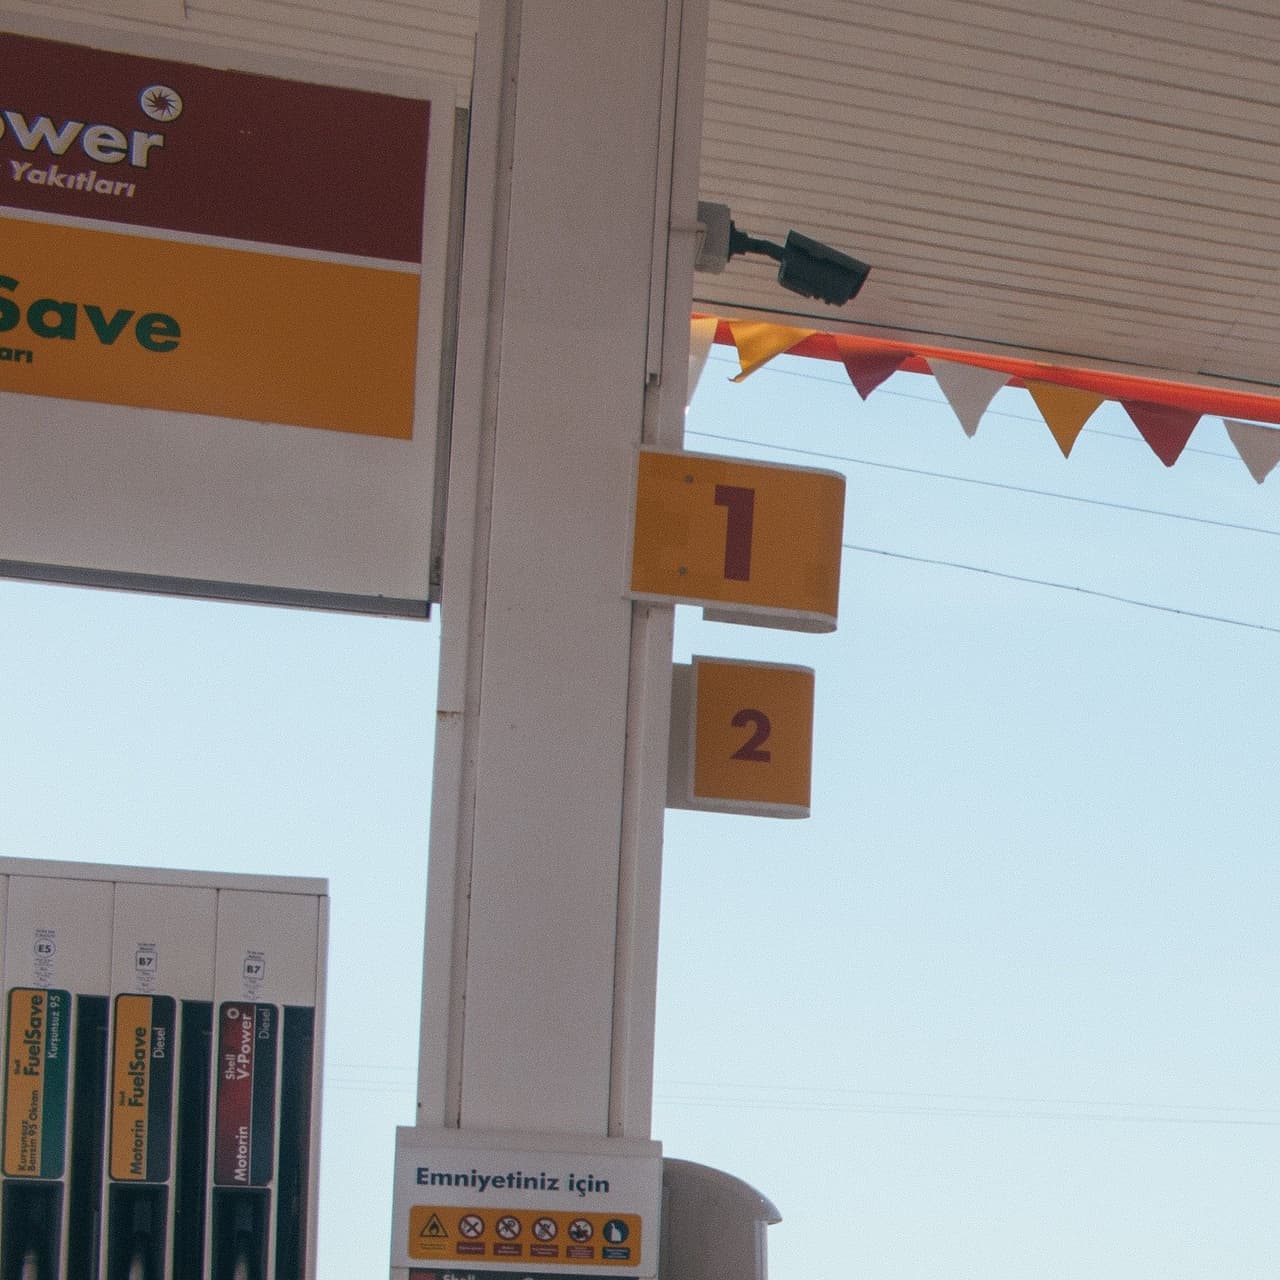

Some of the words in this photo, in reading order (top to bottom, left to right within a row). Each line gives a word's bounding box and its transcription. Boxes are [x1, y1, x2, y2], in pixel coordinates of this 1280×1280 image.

[10, 160, 136, 197] Yakıtları
[714, 484, 755, 582] 1
[730, 708, 772, 763] 2
[38, 944, 52, 953] E5
[138, 957, 154, 966] B7
[246, 965, 261, 974] B7
[24, 995, 43, 1076] FuelSave
[152, 1027, 166, 1058] Diesel
[259, 1008, 271, 1040] Diesel
[236, 1013, 252, 1080] V-Power
[128, 1027, 147, 1107] FuelSave
[225, 1054, 236, 1080] Shell
[131, 1119, 144, 1175] Motorin
[234, 1126, 248, 1182] Motorin
[416, 1167, 560, 1192] Emniyetiniz
[568, 1173, 610, 1197] için
